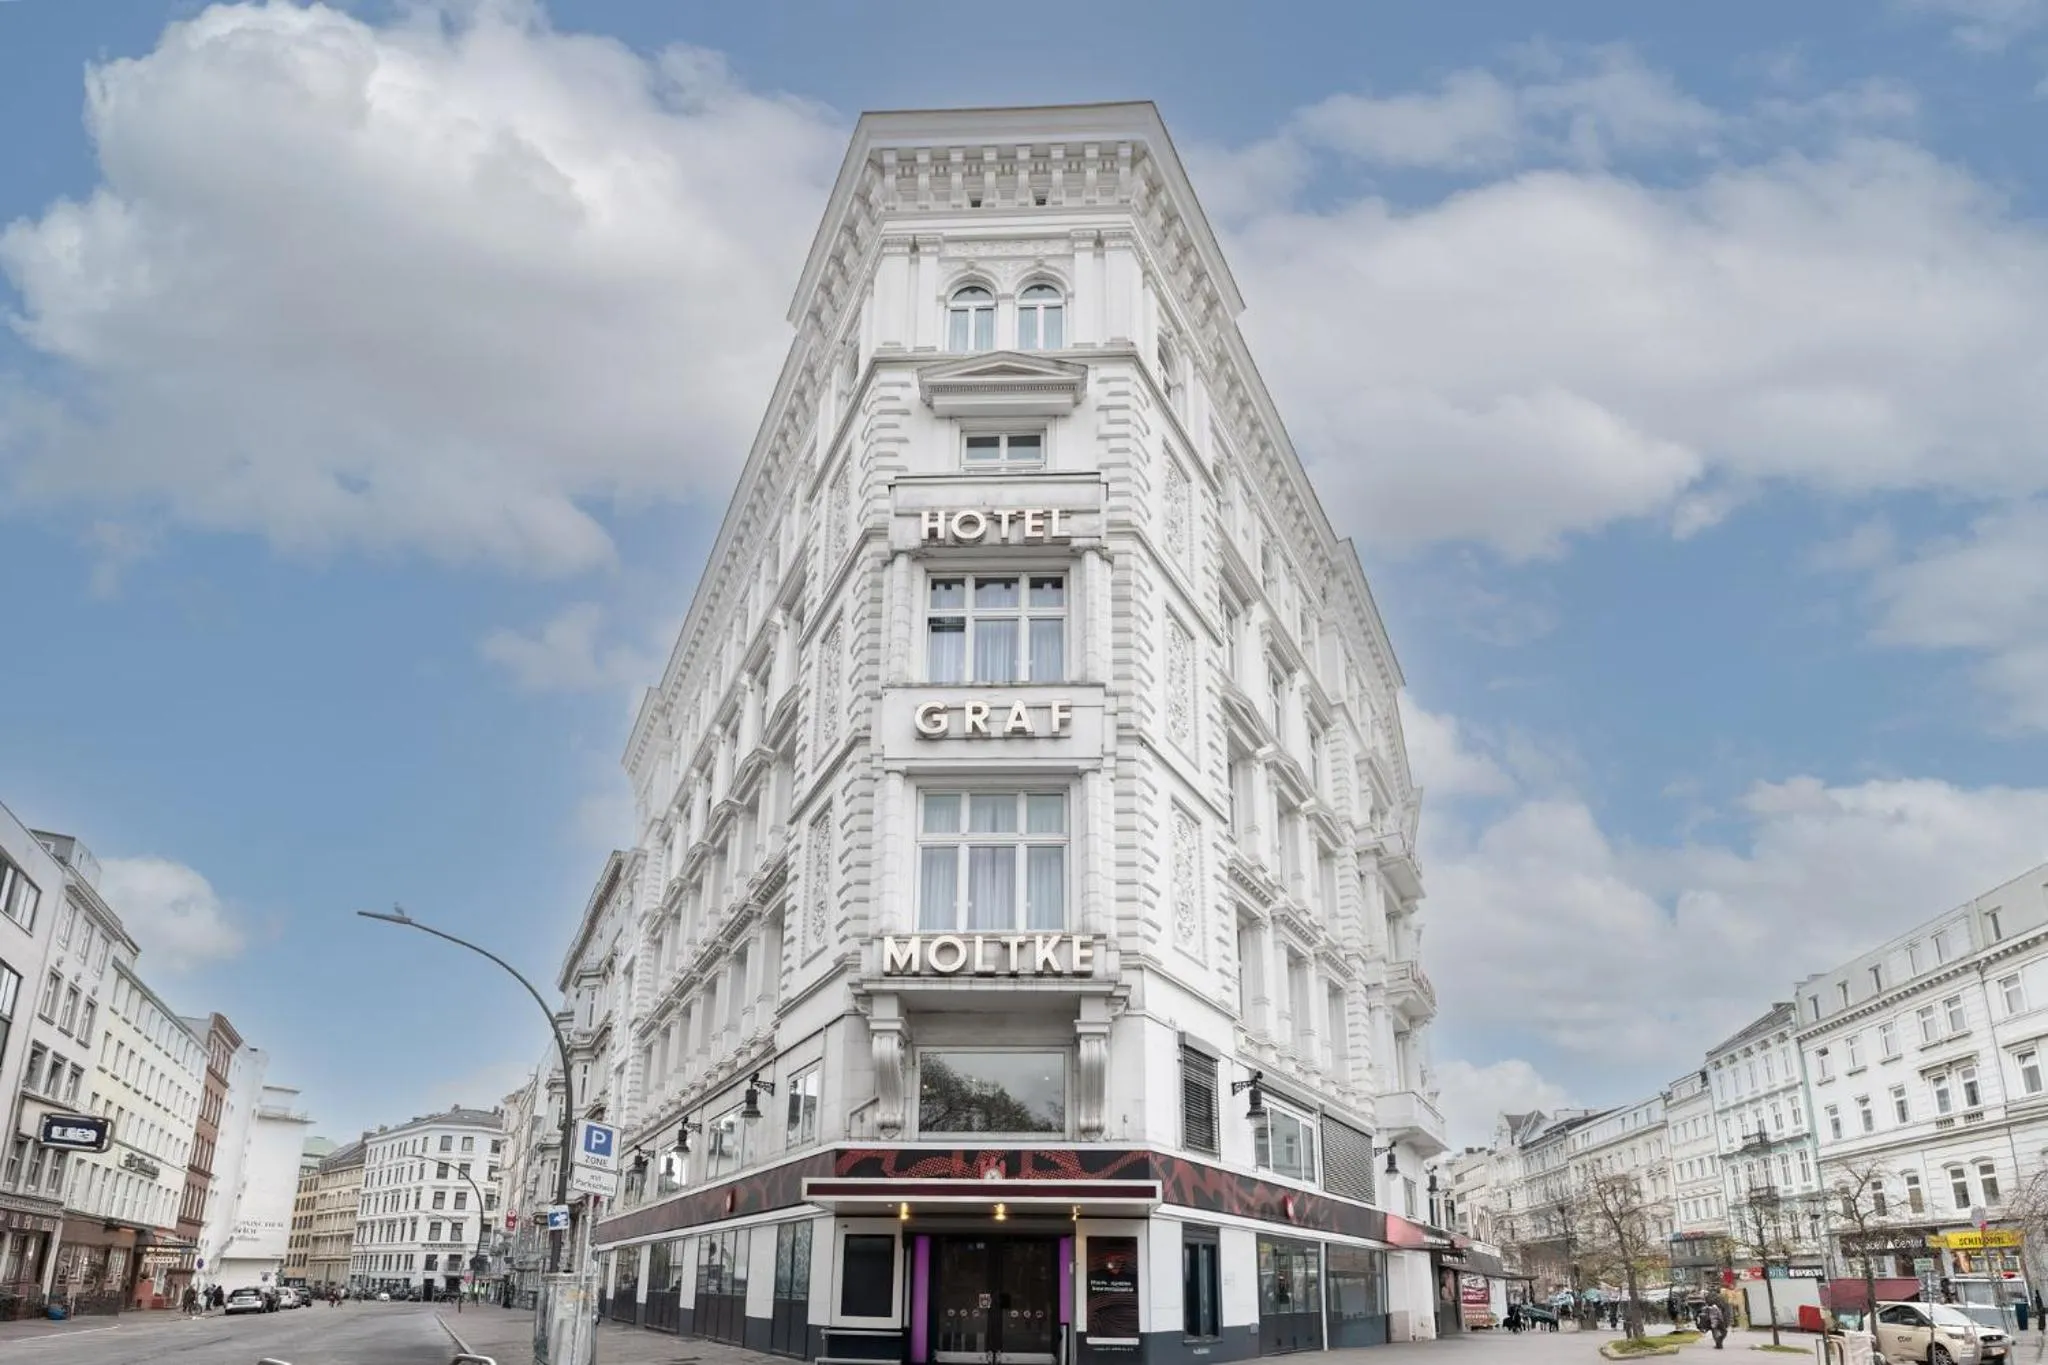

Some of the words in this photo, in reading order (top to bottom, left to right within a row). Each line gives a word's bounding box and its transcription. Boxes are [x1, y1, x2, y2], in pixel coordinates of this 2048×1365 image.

[921, 509, 1071, 544] HOTEL
[914, 699, 1073, 737] GRAF
[882, 934, 1094, 975] MOLTKE
[590, 1130, 606, 1150] P
[585, 1155, 608, 1167] ZONE
